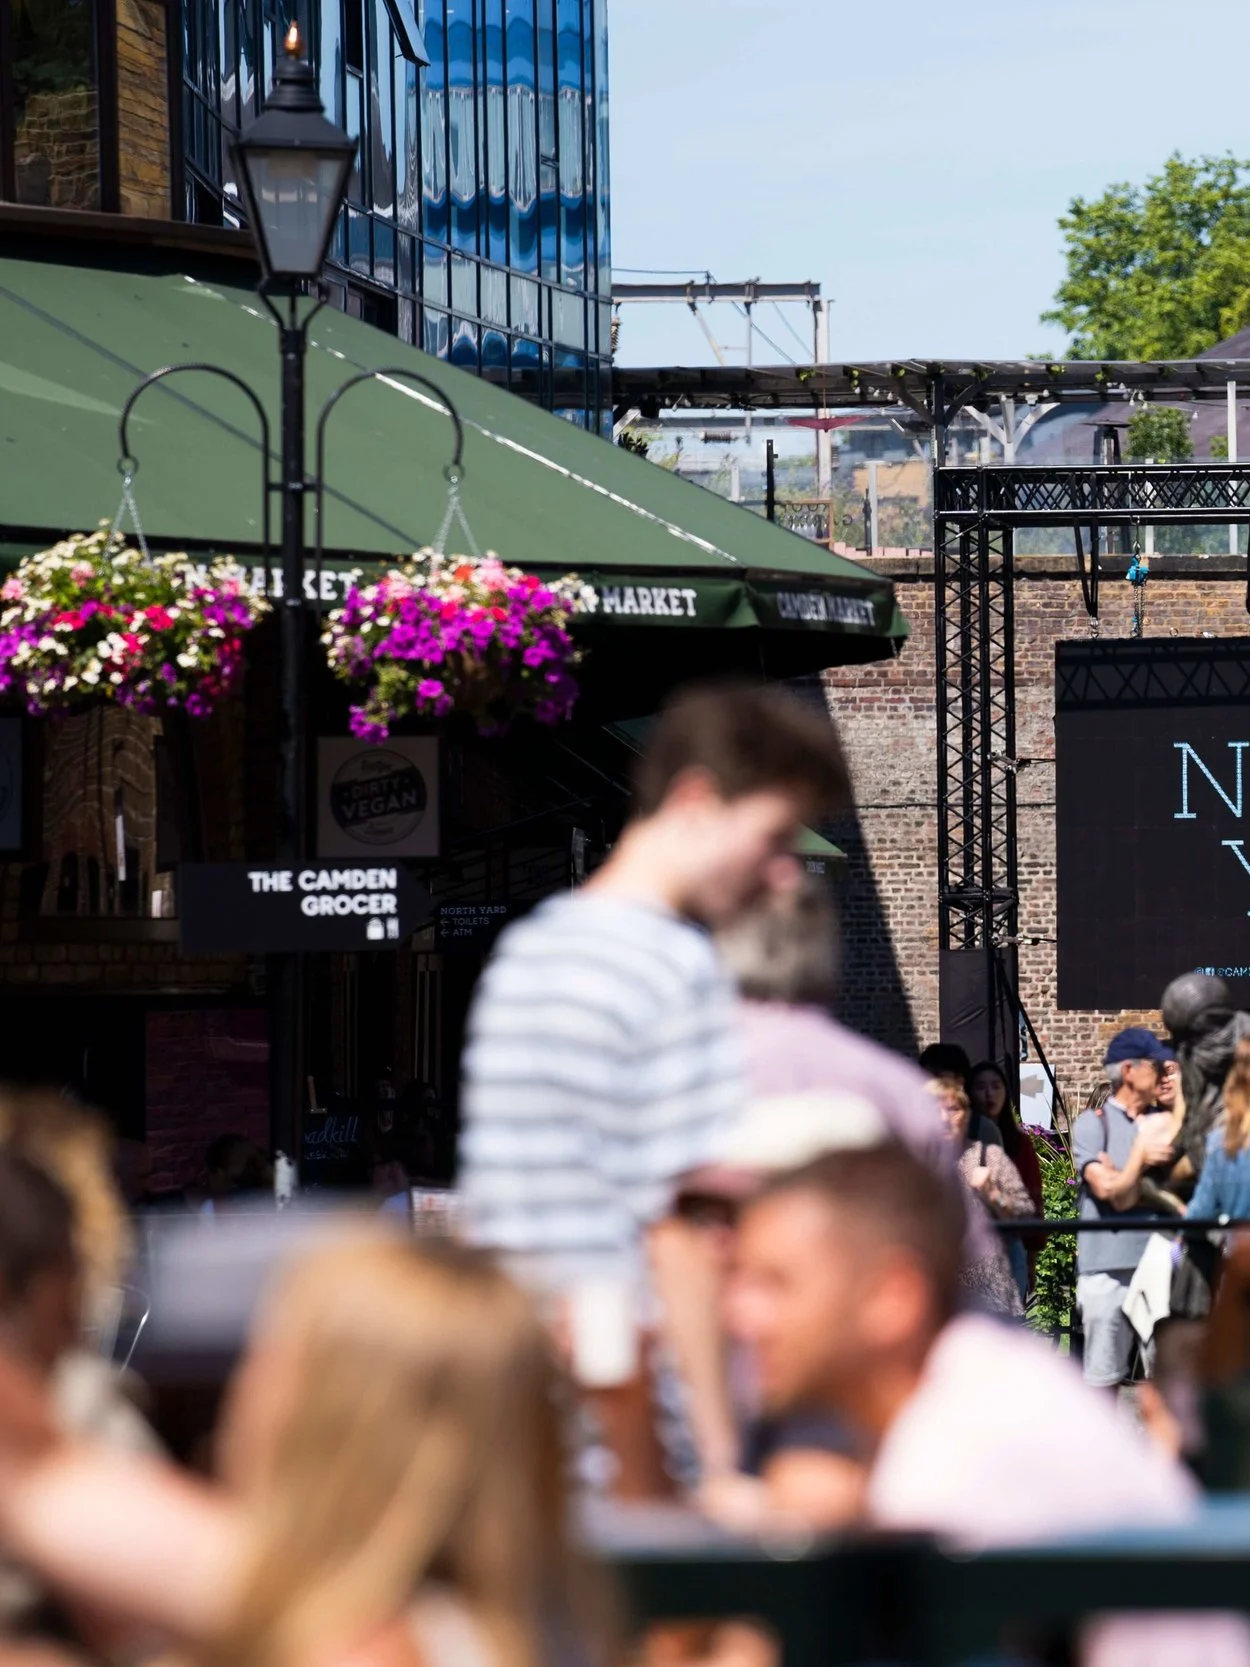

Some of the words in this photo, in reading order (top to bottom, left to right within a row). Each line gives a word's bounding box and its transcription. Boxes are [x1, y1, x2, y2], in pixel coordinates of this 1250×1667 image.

[602, 586, 697, 617] MARKET
[351, 776, 400, 799] DIRTY
[340, 789, 417, 820] VEGAN
[248, 870, 294, 892] THE
[298, 868, 397, 891] CAMDEN
[301, 893, 398, 916] GROCER
[440, 906, 476, 916] NORTH
[478, 905, 507, 914] YARD
[452, 917, 491, 926] TOILETS
[452, 928, 473, 936] ATM
